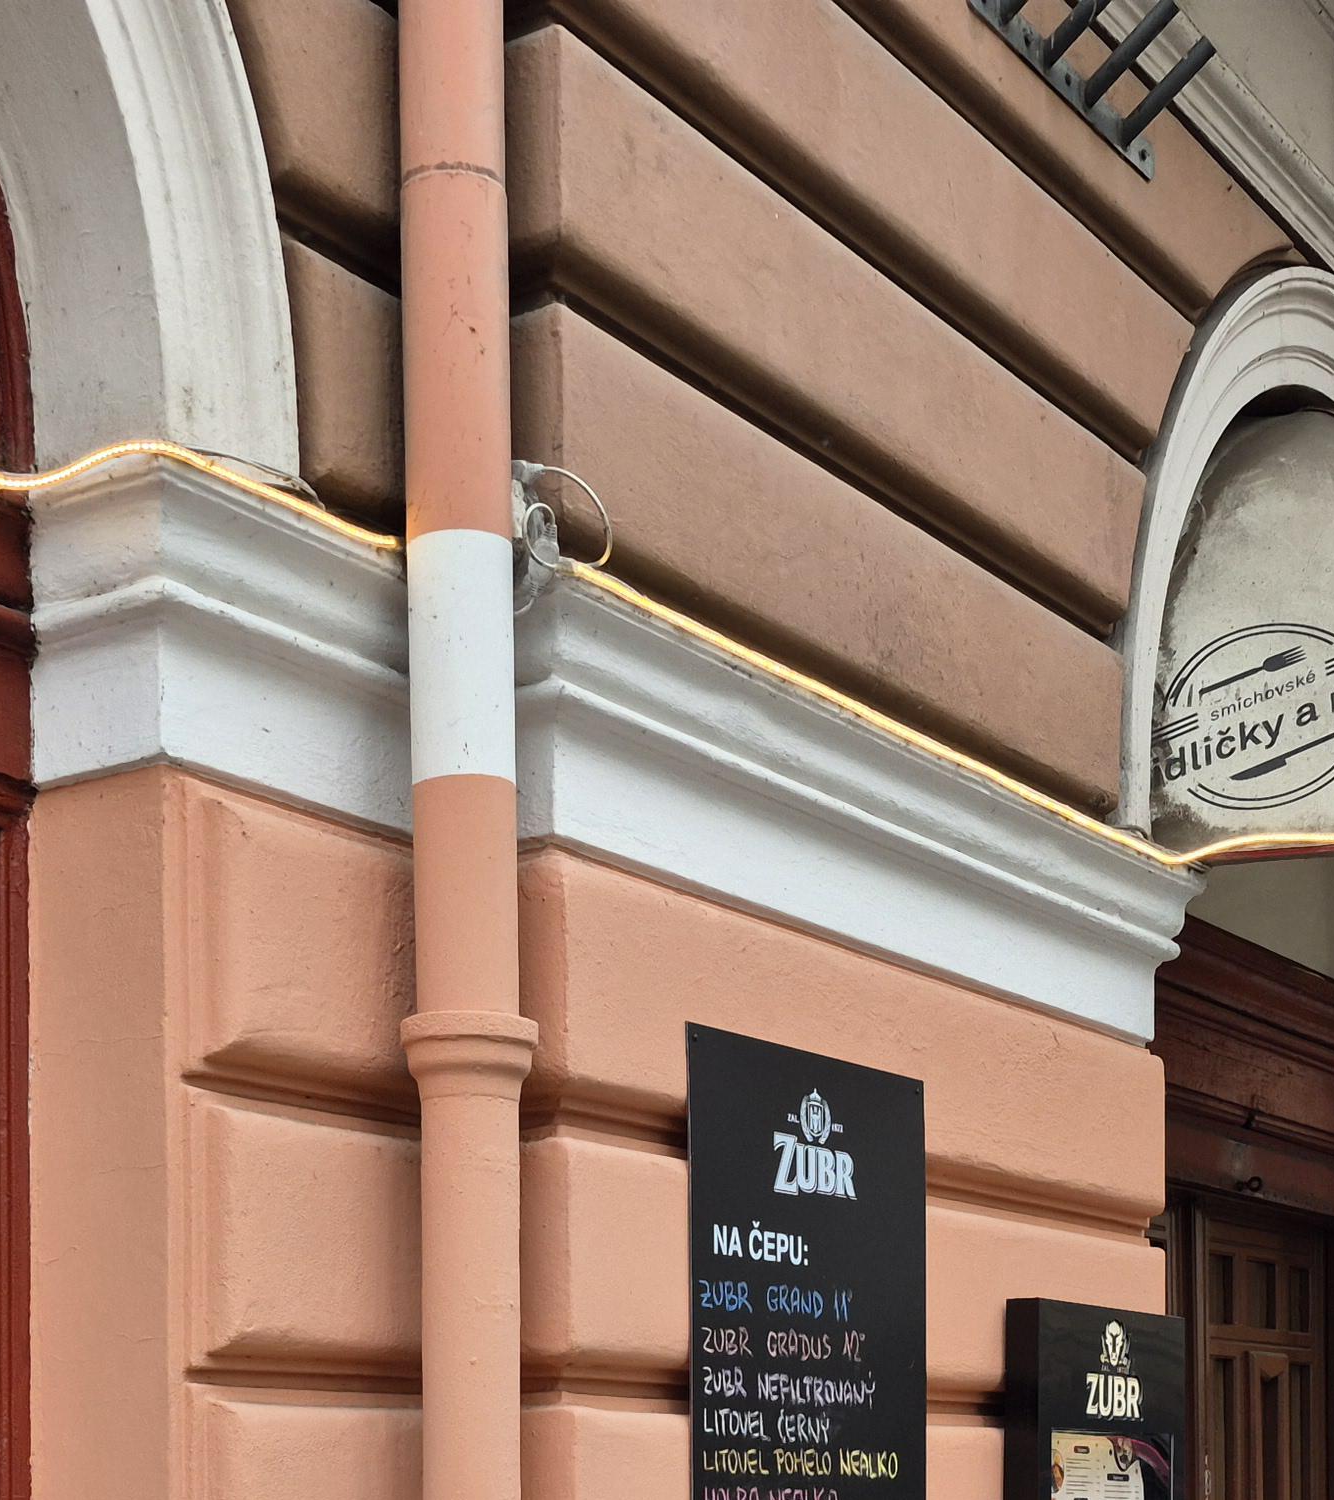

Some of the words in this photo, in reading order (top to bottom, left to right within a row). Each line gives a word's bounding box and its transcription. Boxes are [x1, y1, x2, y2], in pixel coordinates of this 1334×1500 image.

[1210, 670, 1316, 721] smíchovské
[1152, 713, 1285, 787] idličky
[1296, 702, 1318, 727] a
[773, 1130, 858, 1200] ZUBR
[713, 1223, 743, 1258] NA
[748, 1220, 808, 1266] ČEPU:
[699, 1280, 752, 1314] ZUBR
[767, 1284, 824, 1319] GRAND
[701, 1326, 754, 1357] ZUBR
[767, 1328, 831, 1361] GRADUS
[702, 1366, 747, 1397] ZUBR
[757, 1371, 876, 1409] NEFILTROVANÝ
[1086, 1373, 1141, 1419] ZUBR
[703, 1407, 771, 1441] LITOVEL
[777, 1409, 830, 1445] ČERNÝ
[703, 1448, 769, 1475] LITOVEL
[840, 1448, 898, 1479] NEALKO
